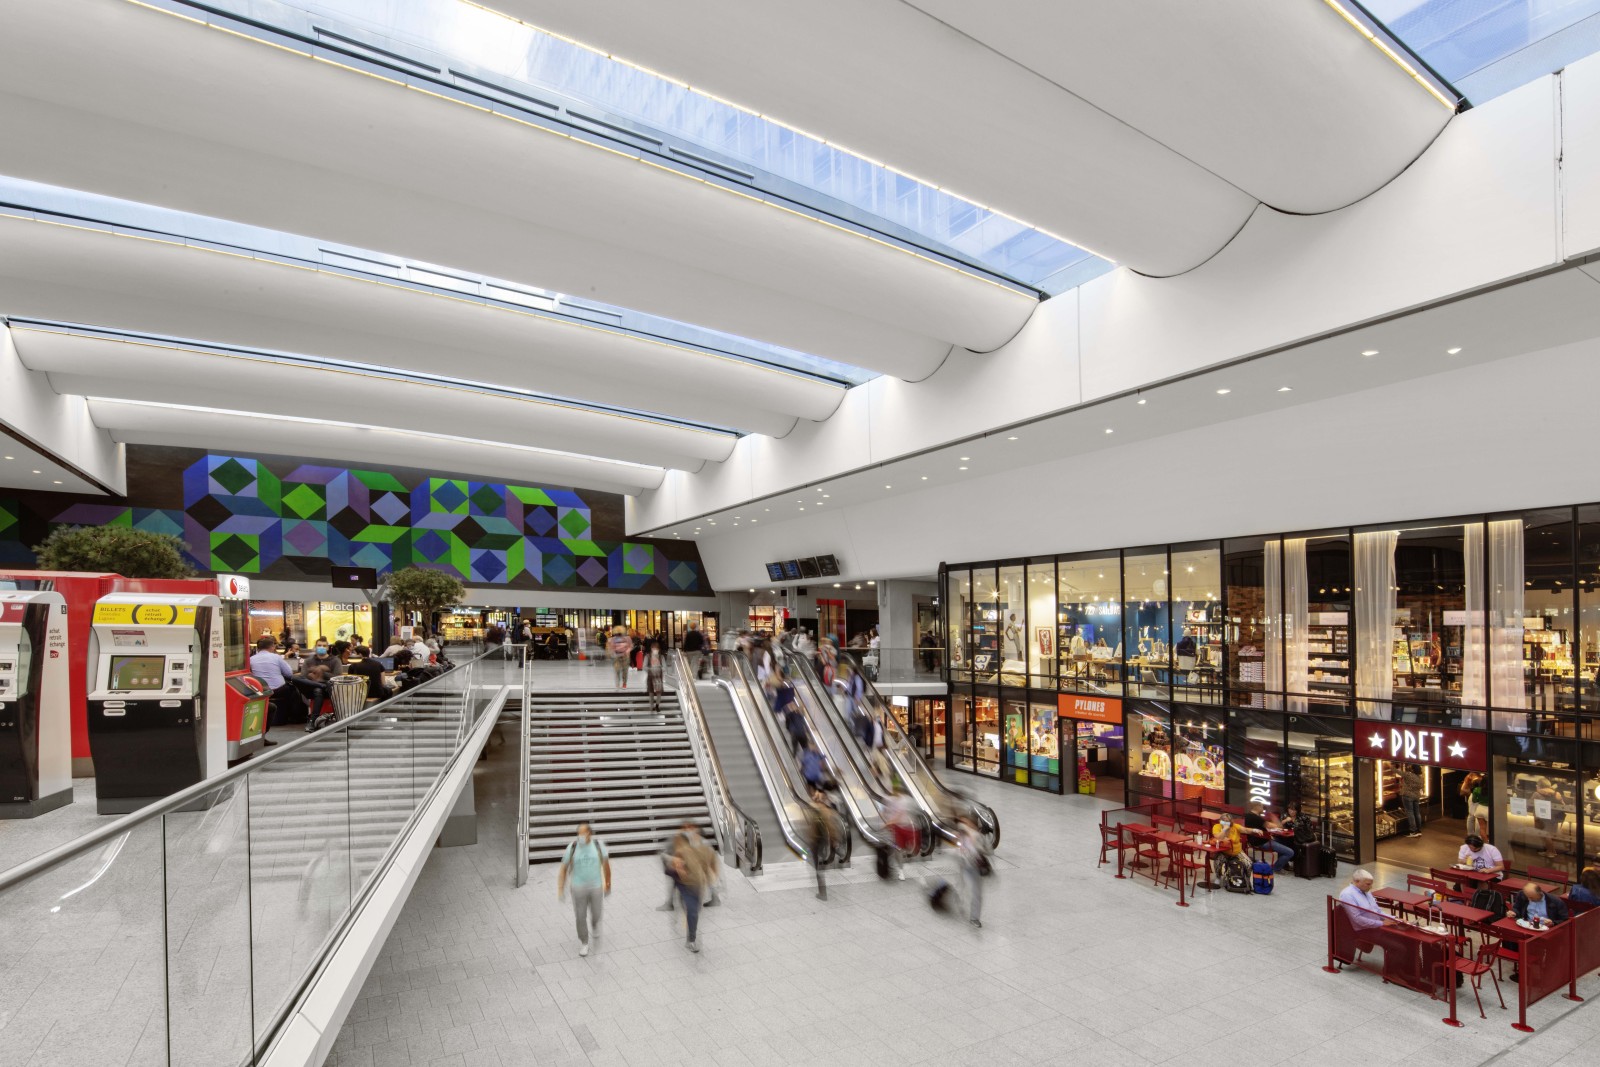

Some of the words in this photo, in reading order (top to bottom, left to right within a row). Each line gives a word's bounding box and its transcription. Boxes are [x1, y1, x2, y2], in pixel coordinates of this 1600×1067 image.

[317, 602, 361, 611] swatch
[1074, 699, 1106, 713] PYLONES
[1391, 728, 1443, 763] PRET
[1249, 769, 1271, 806] PRET
